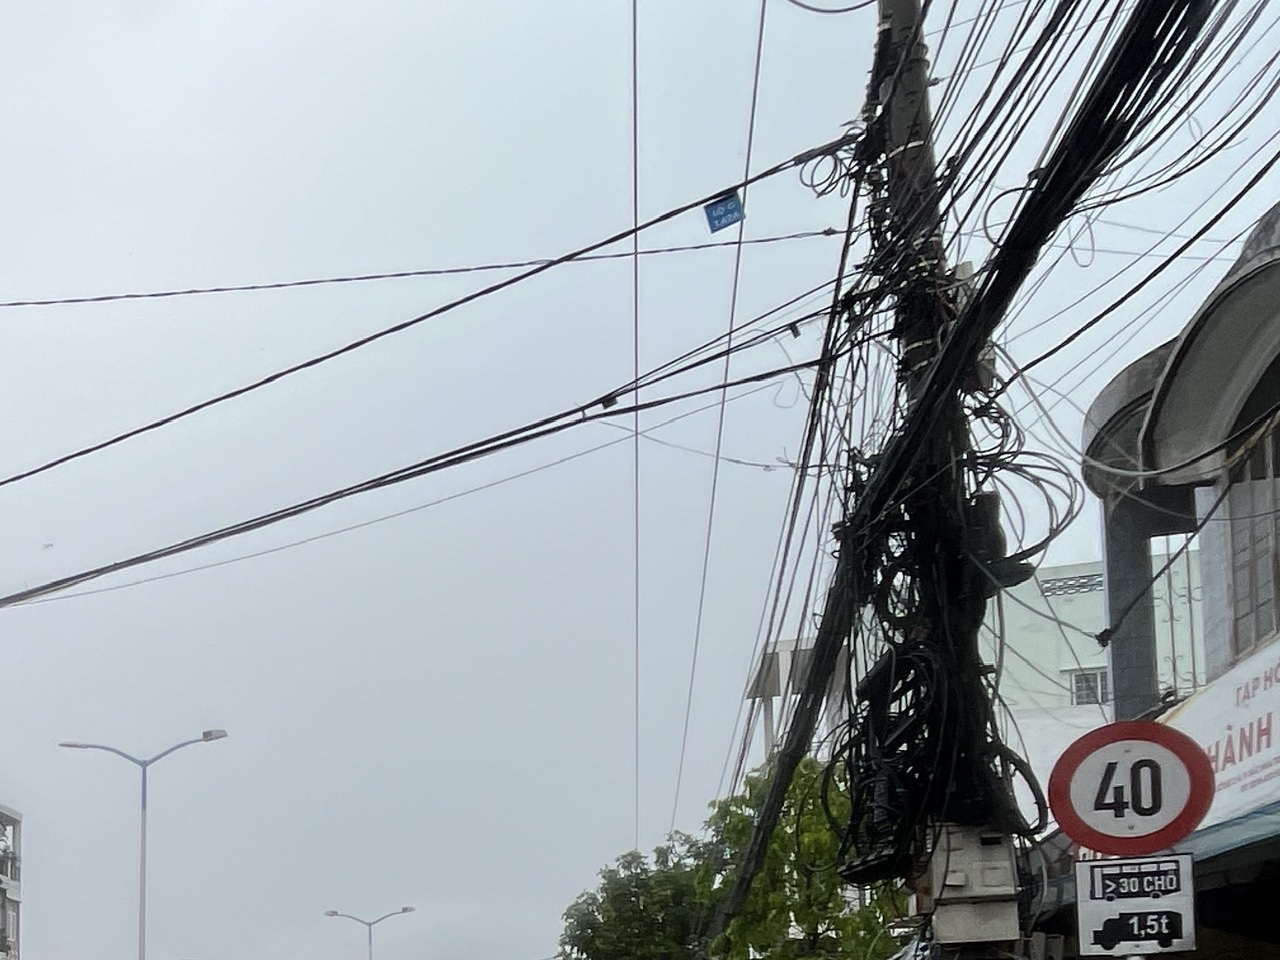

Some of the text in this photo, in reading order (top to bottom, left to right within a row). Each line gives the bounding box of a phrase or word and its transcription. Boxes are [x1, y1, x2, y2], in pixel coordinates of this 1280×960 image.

[1207, 711, 1272, 774] HÀNH
[1093, 758, 1162, 818] 40
[1128, 914, 1169, 937] 1,5t
